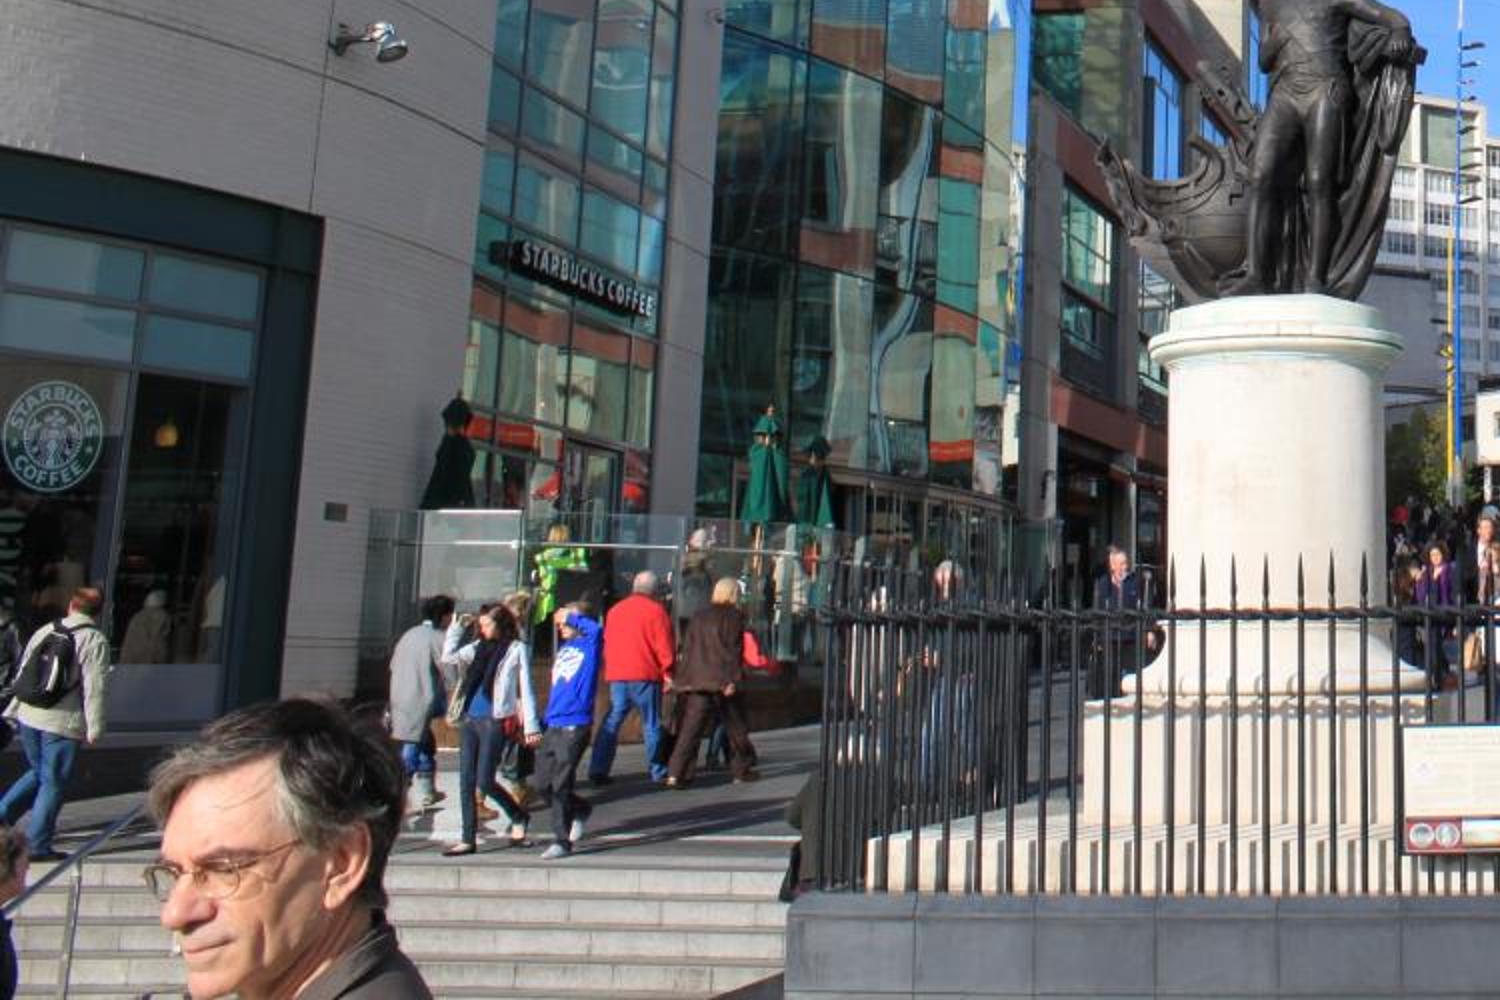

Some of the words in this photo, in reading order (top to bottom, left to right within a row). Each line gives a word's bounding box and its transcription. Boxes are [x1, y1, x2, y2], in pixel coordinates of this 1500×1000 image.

[522, 241, 604, 296] STARBUCKS
[607, 280, 653, 317] COFFEE
[11, 386, 98, 437] STARBUCKS
[15, 455, 84, 487] COFFEE
